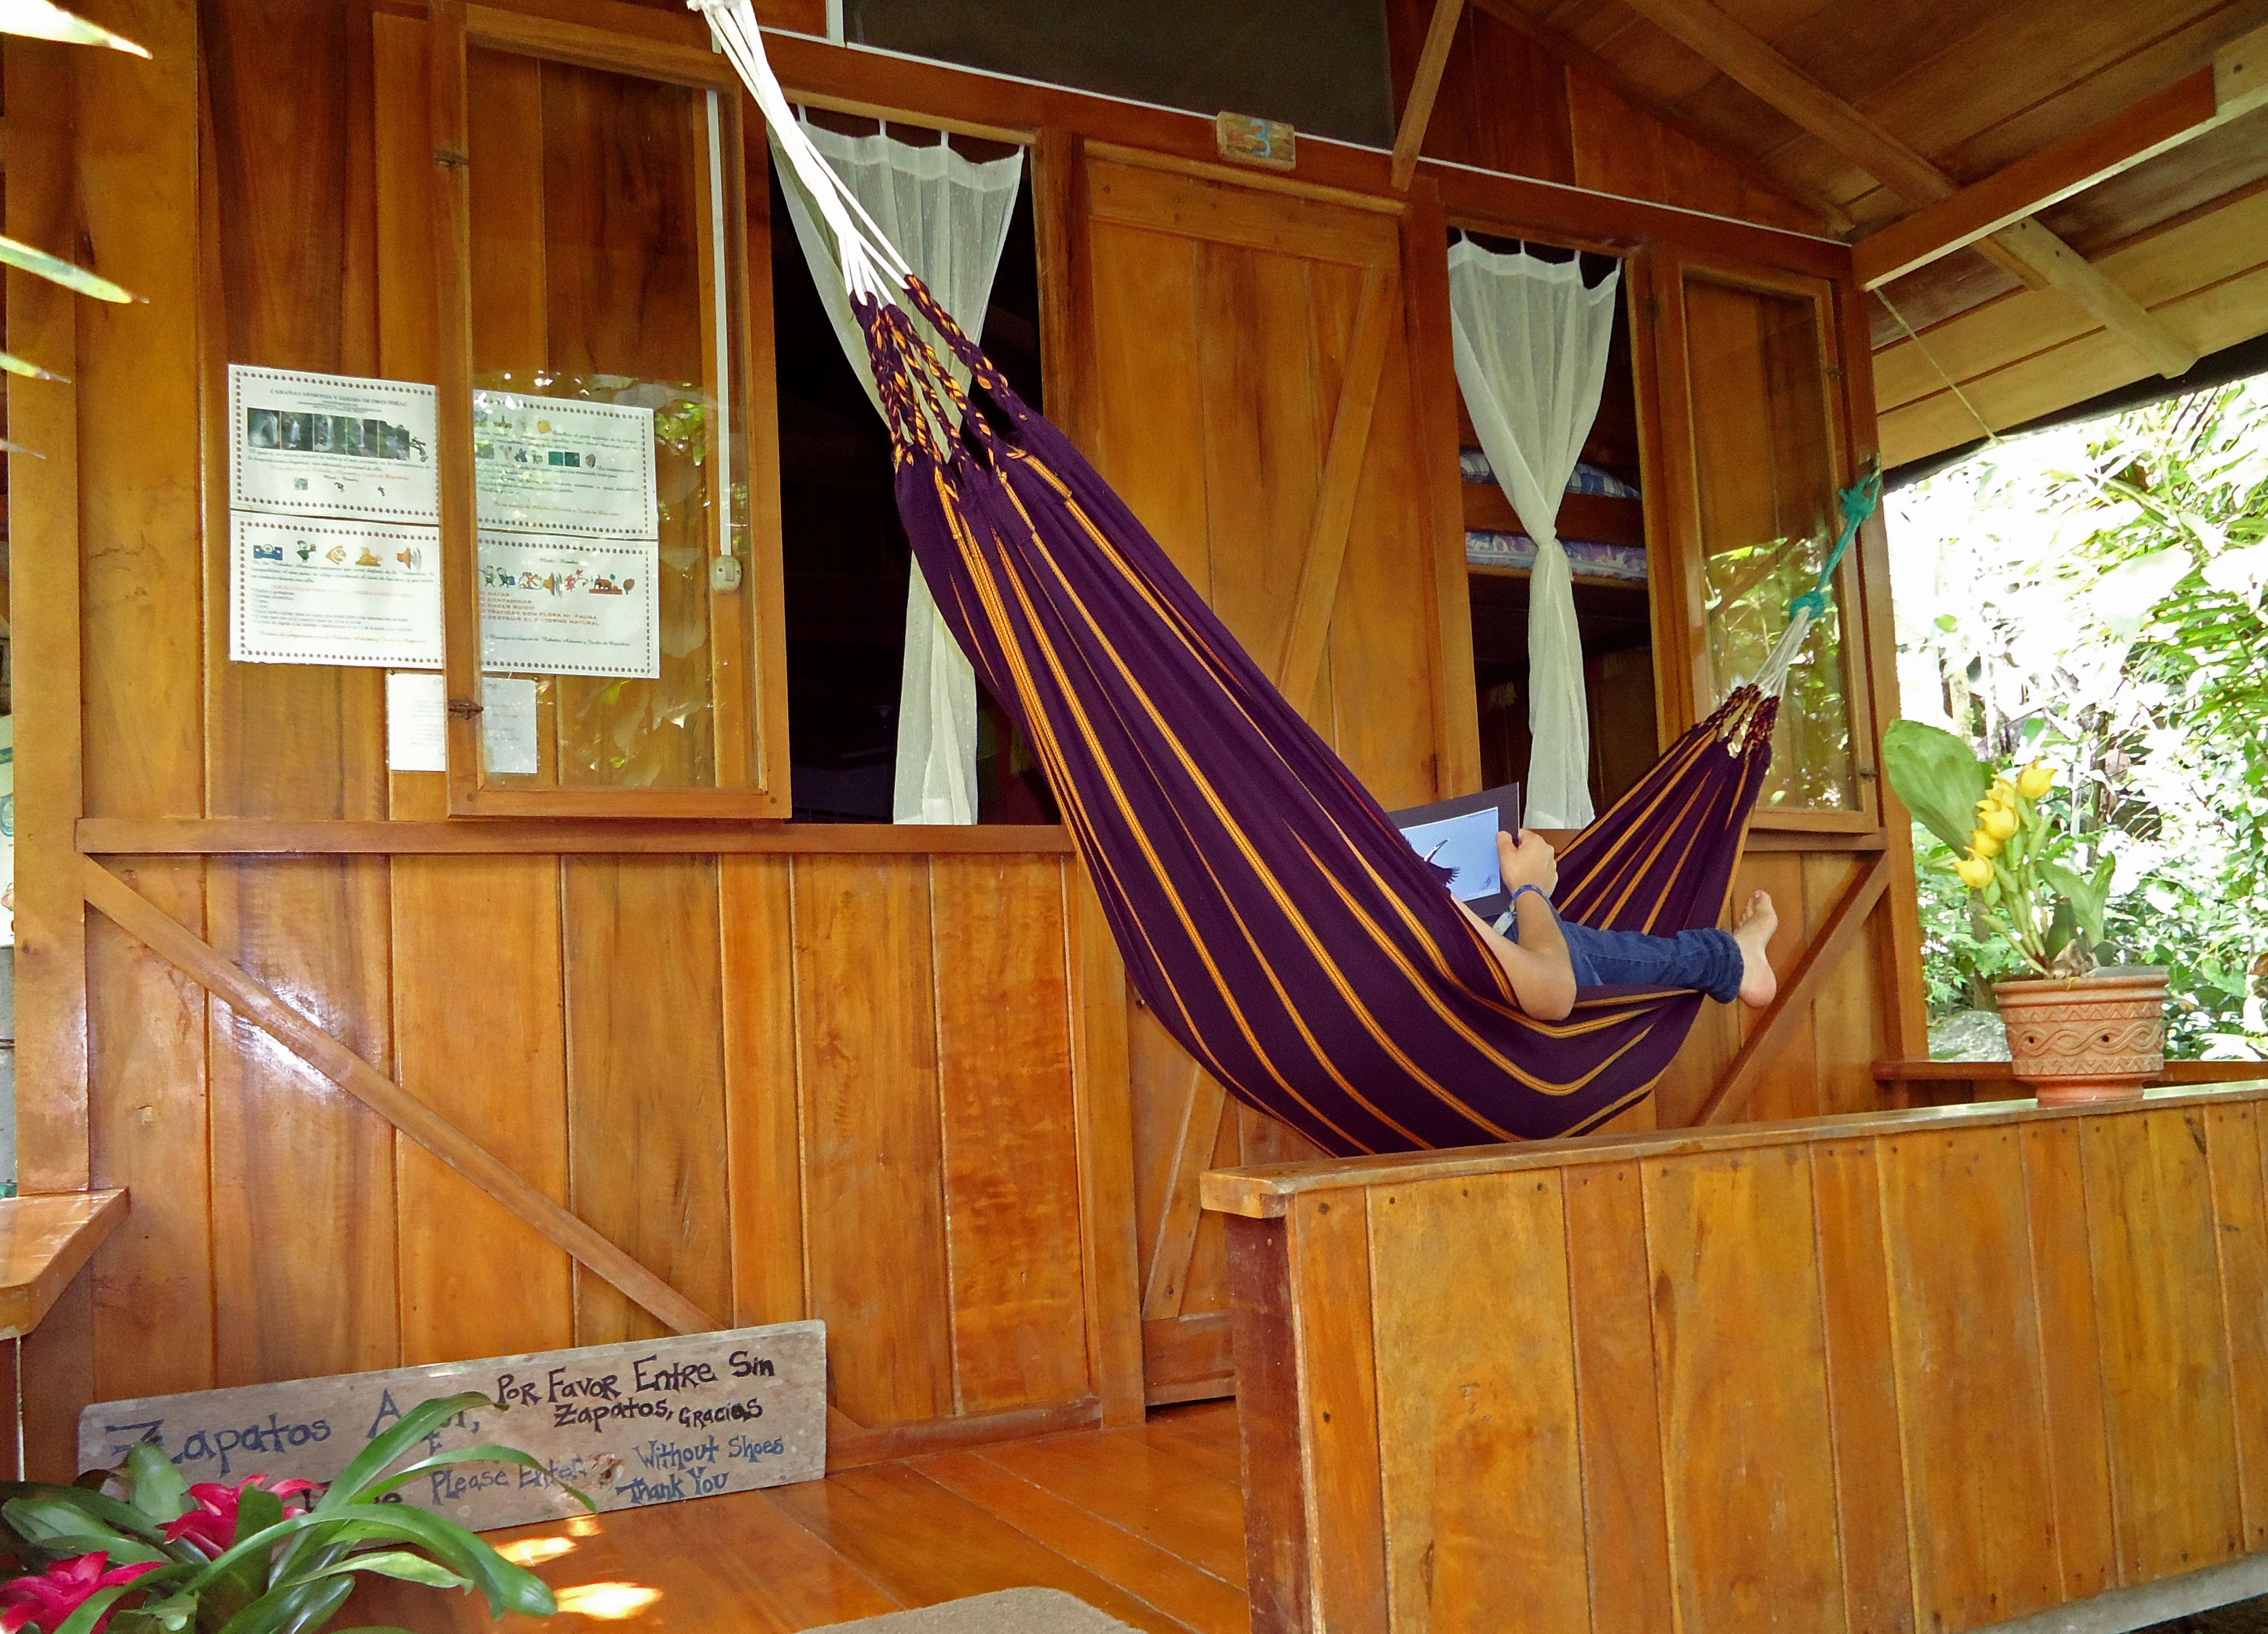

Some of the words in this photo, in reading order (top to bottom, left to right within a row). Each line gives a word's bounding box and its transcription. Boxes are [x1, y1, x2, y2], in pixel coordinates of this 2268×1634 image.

[1248, 118, 1271, 157] 3
[728, 1351, 775, 1378] Sin
[553, 1397, 674, 1433] Zapatos,
[632, 1434, 719, 1470] Without
[728, 1434, 785, 1463] Shoes
[615, 1473, 687, 1503] Thank
